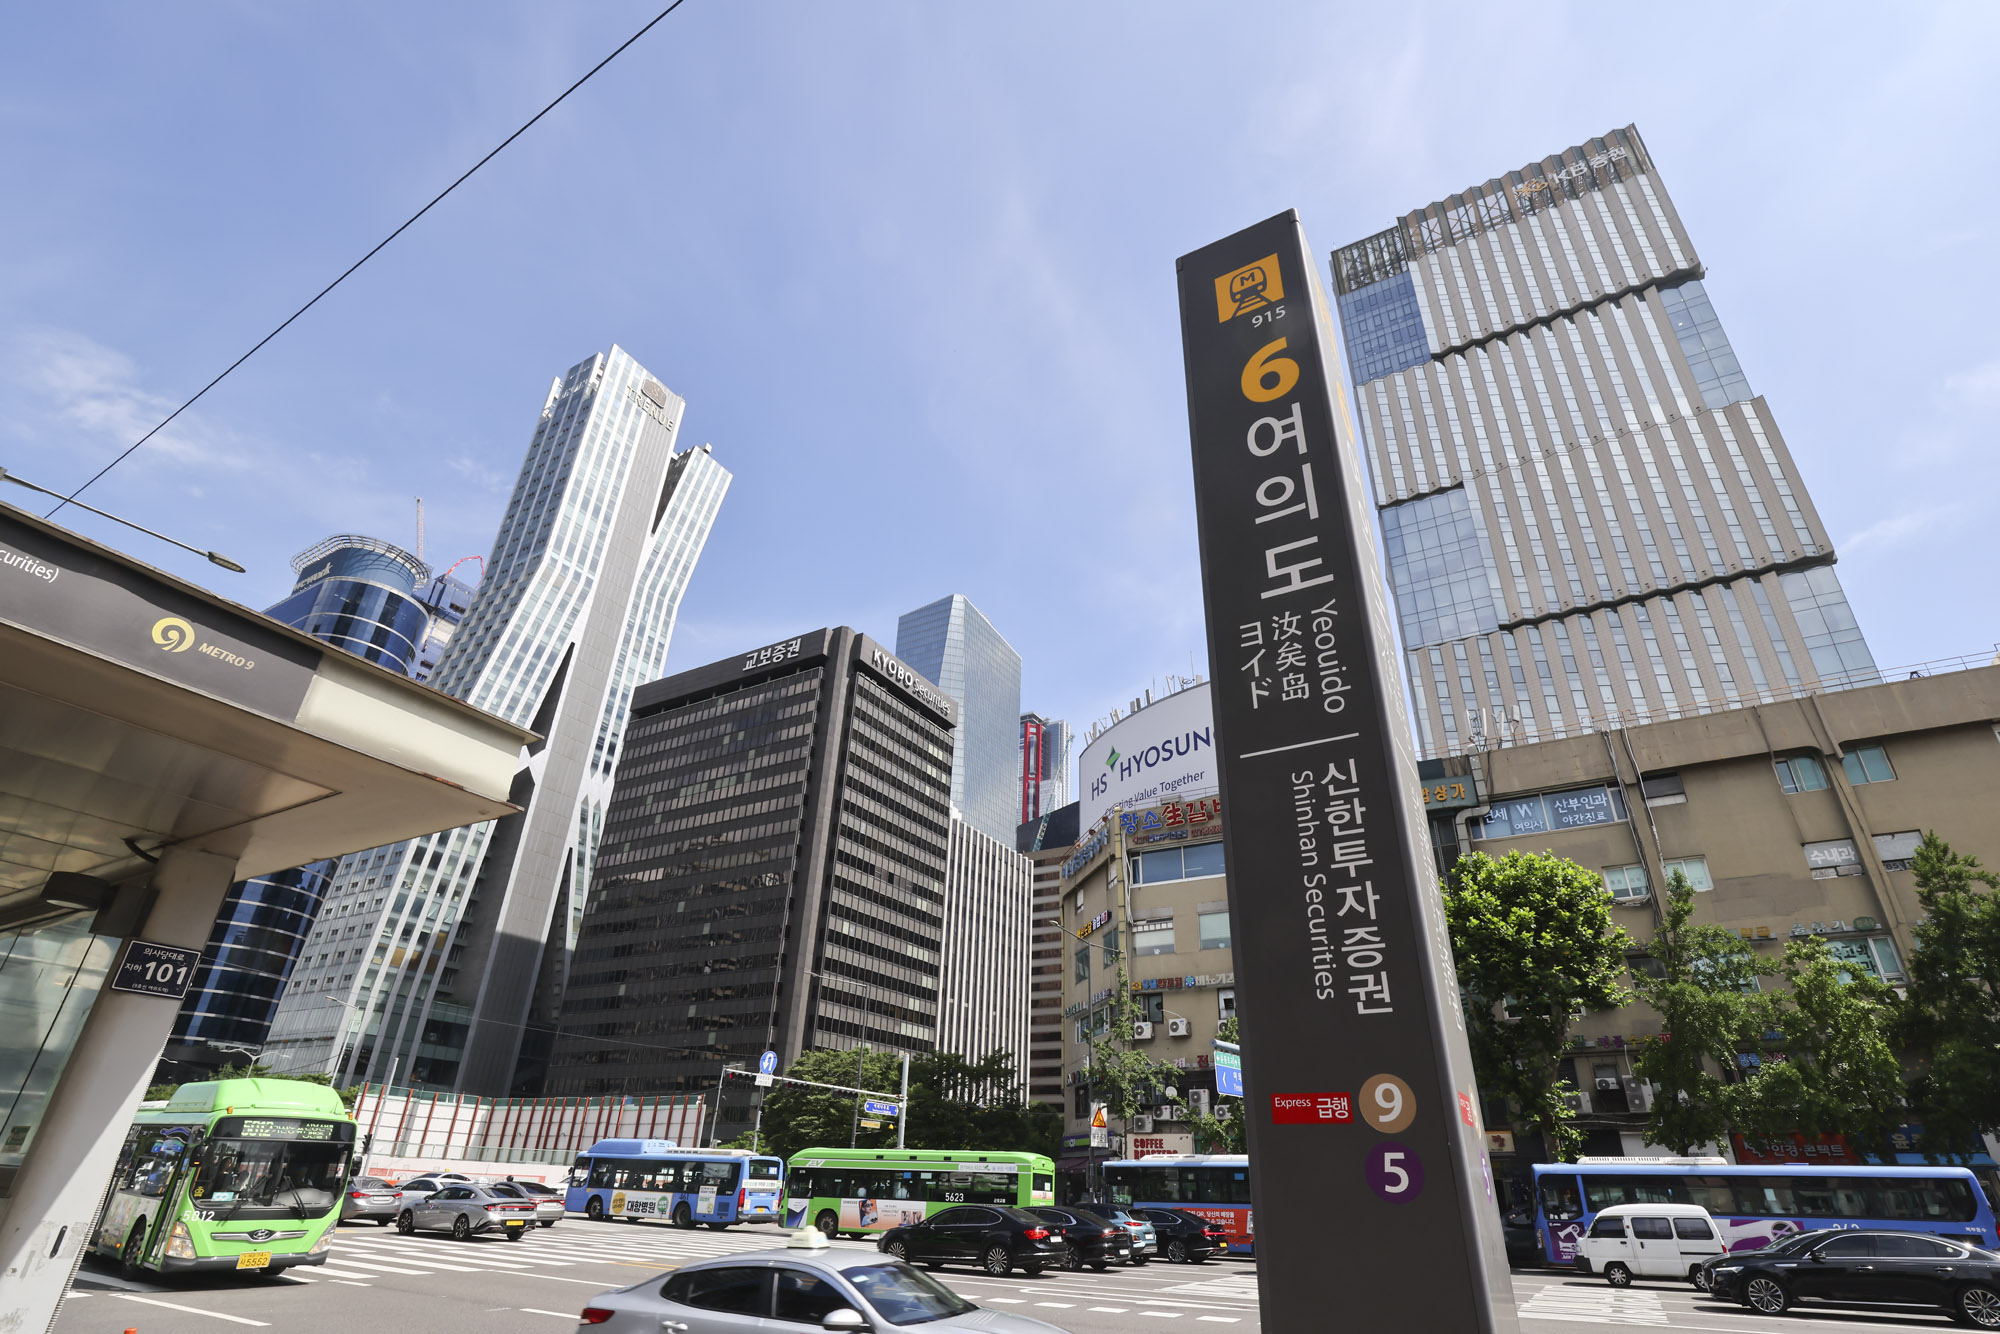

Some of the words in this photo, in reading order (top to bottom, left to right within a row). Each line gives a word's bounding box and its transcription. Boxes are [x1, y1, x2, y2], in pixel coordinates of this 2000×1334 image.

[1251, 305, 1286, 328] 915
[1240, 336, 1300, 403] 6
[1247, 401, 1334, 599] 여의도
[198, 642, 244, 667] METRO
[244, 660, 255, 670] 9
[742, 638, 801, 671] 교보증권
[1239, 621, 1272, 710] ヨイド
[1271, 611, 1310, 702] 汝矣岛
[1310, 598, 1352, 714] Yeouido
[873, 648, 914, 686] KYOBO
[914, 678, 951, 714] Securities
[1091, 772, 1108, 801] HS
[1120, 726, 1215, 782] HYOSUN
[1134, 786, 1158, 803] Value
[1160, 770, 1205, 792] Together
[1291, 770, 1320, 867] Shinhan
[1554, 793, 1608, 814] 산부인과
[1514, 819, 1544, 831] 여의사
[1562, 811, 1607, 825] 야간진료
[1320, 758, 1393, 1015] 신한투자증권
[1303, 873, 1337, 1000] Securities
[143, 947, 185, 961] 의사당대로
[124, 962, 142, 973] 지하
[145, 961, 188, 985] 101
[1274, 1097, 1311, 1110] Express
[1316, 1097, 1349, 1119] 급행
[1374, 1082, 1403, 1123] 9
[1133, 1138, 1164, 1149] COFFEE
[1384, 1152, 1409, 1194] 5
[627, 1200, 656, 1214] 대항병원
[945, 1193, 964, 1202] 5623
[181, 1210, 215, 1222] 5012
